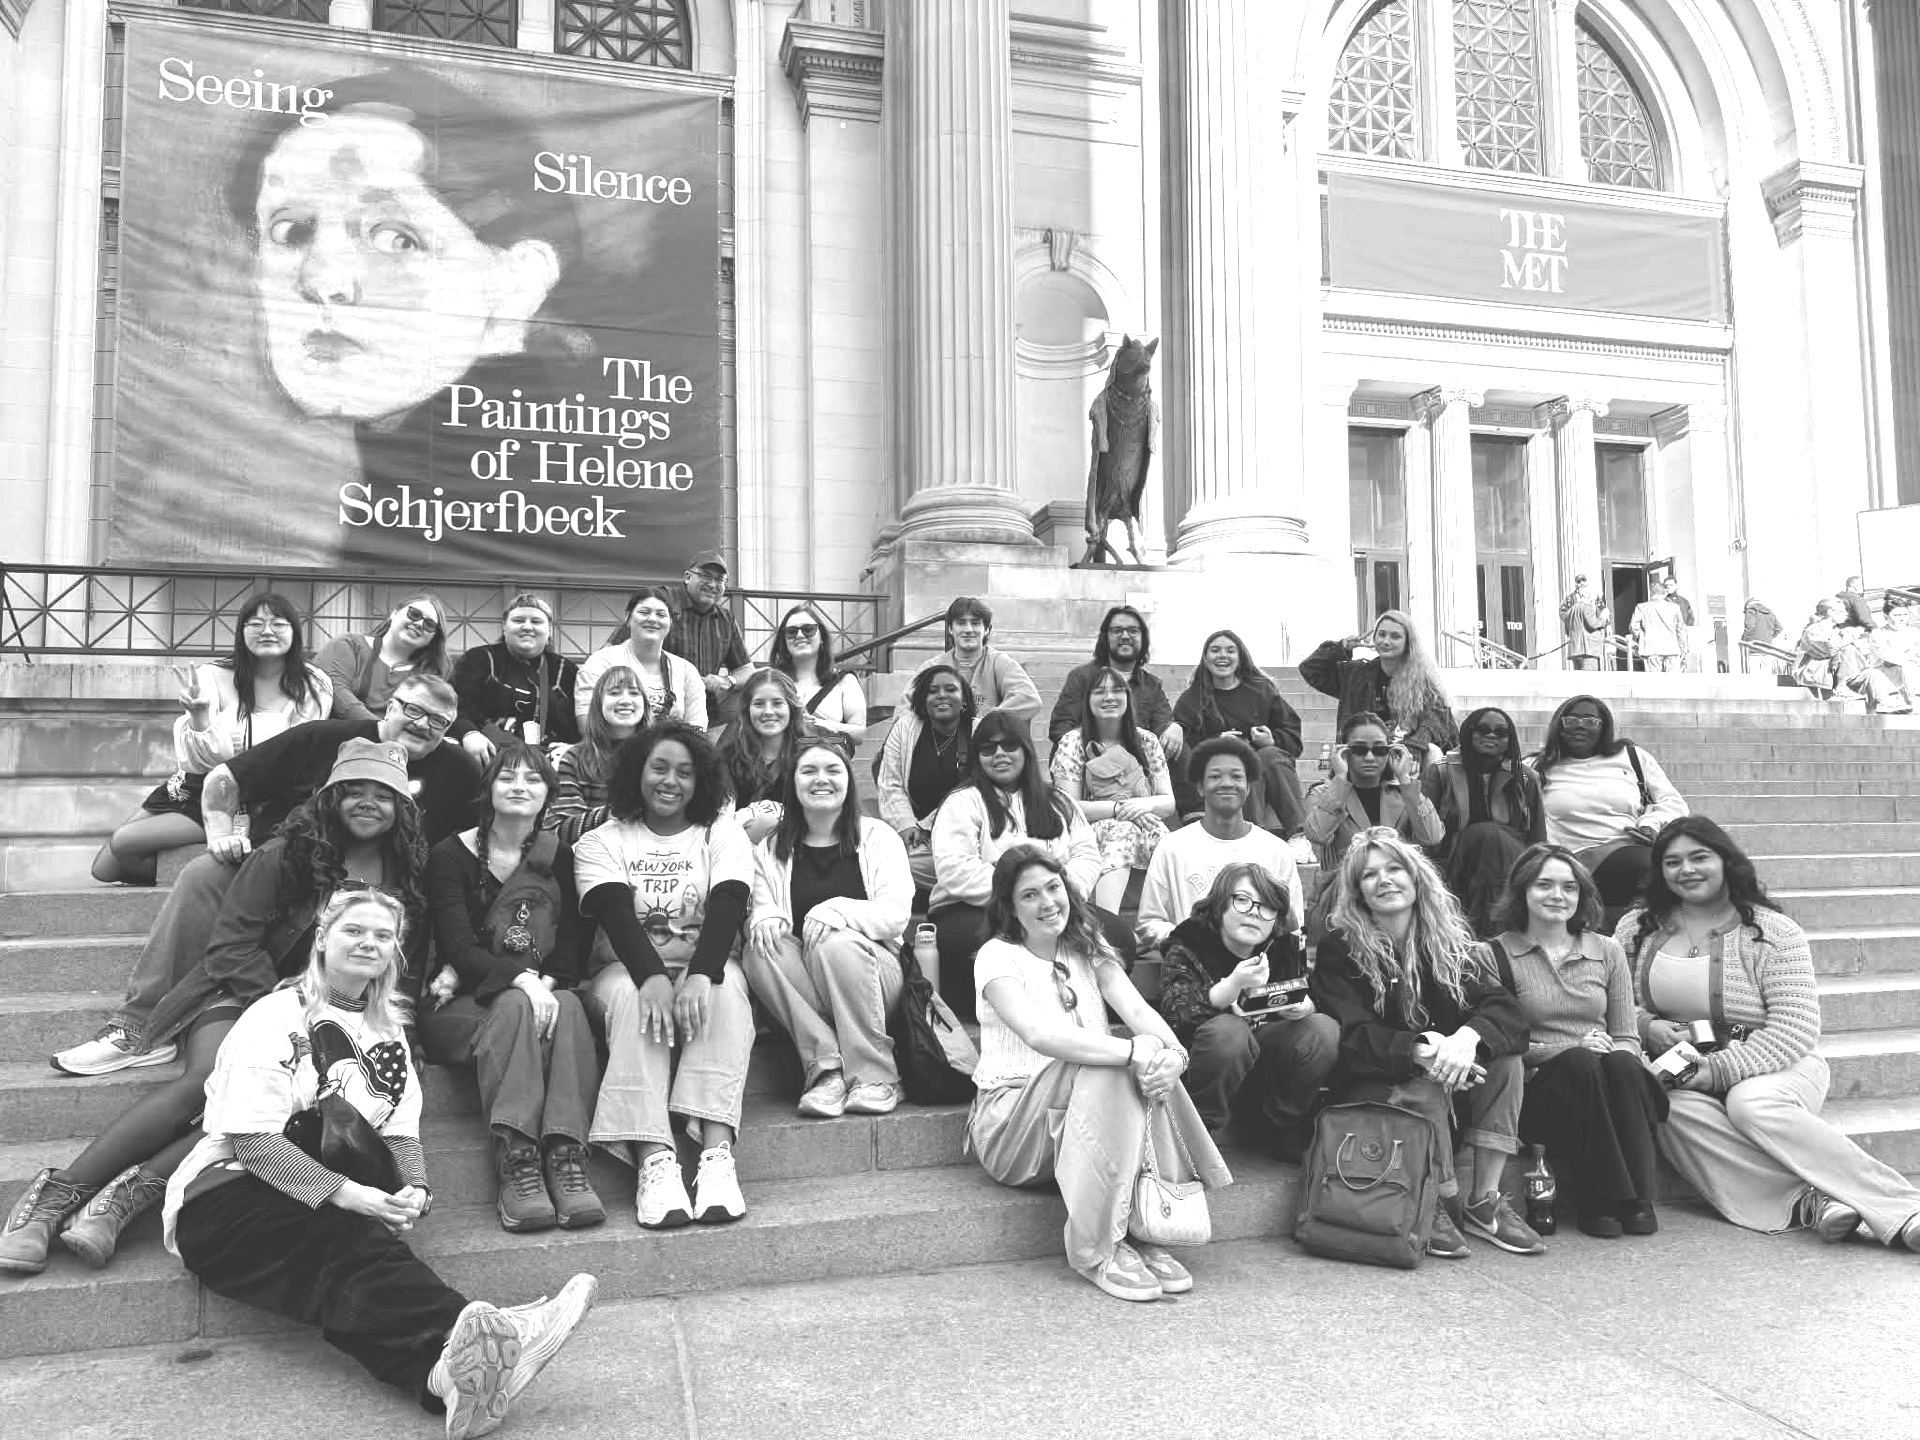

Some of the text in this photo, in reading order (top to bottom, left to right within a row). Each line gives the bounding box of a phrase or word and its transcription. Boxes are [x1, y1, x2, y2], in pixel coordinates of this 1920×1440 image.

[159, 57, 334, 128] Seeing
[534, 152, 692, 205] Silence
[1500, 208, 1567, 253] THE
[1500, 249, 1568, 293] MET
[603, 358, 693, 404] The
[442, 385, 670, 449] Paintings
[470, 440, 693, 491] of Helene
[338, 482, 626, 542] Schjerfbeck
[629, 859, 693, 873] NEW YORK
[642, 878, 680, 894] TRIP
